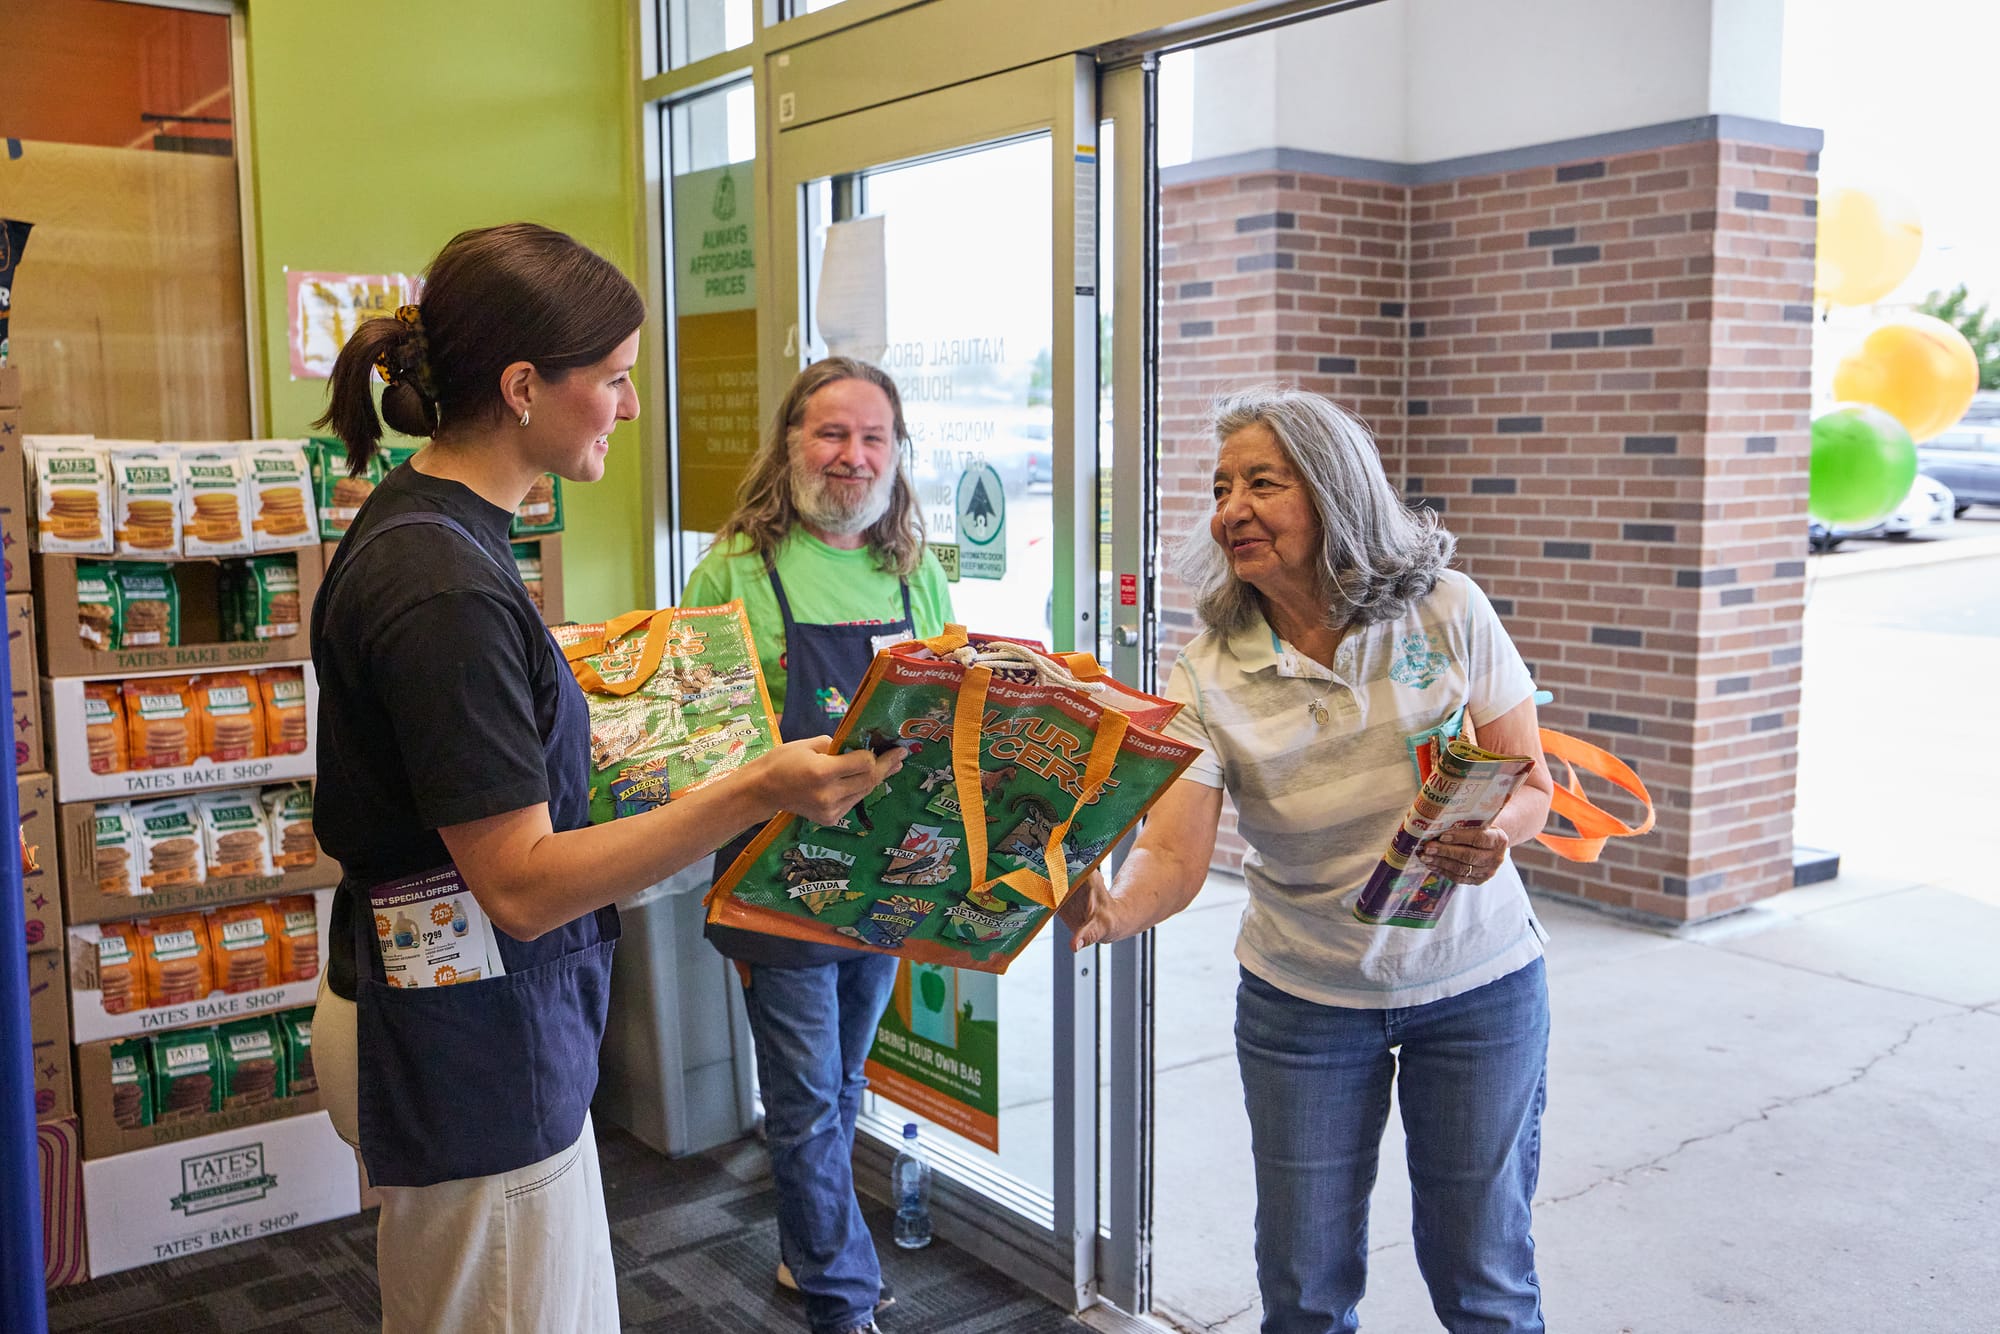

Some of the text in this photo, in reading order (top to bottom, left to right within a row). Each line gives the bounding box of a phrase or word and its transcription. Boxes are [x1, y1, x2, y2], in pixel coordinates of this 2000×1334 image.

[702, 224, 748, 249] ALWAYS
[690, 249, 755, 275] AFFORDABL
[705, 275, 745, 297] PRICES
[176, 648, 219, 662] BAKE
[895, 664, 922, 678] Your
[1053, 691, 1098, 719] Grocery
[1127, 734, 1156, 751] Since
[1158, 745, 1188, 758] 1955!
[899, 717, 1100, 805] GRCERS
[125, 762, 273, 791] TATE'S BAKE SHOP
[623, 778, 663, 797] ARIZONA
[940, 798, 962, 813] IDA
[889, 848, 914, 859] UTAH
[388, 892, 426, 905] SPECIAL
[426, 883, 460, 897] OFFERS
[797, 881, 840, 895] NEVADA
[873, 913, 914, 927] ARIZONA
[951, 907, 1021, 928] NEW MEXICO
[139, 990, 286, 1028] TATE'S BAKE SHOP
[878, 1027, 906, 1052] BRING
[908, 1040, 933, 1064] YOUR
[935, 1052, 958, 1076] OWN
[960, 1063, 982, 1087] BAG
[187, 1150, 258, 1181] TATE'S
[197, 1170, 252, 1188] BAKE SHOP
[154, 1212, 299, 1258] TATE'S BAKE SHOP
